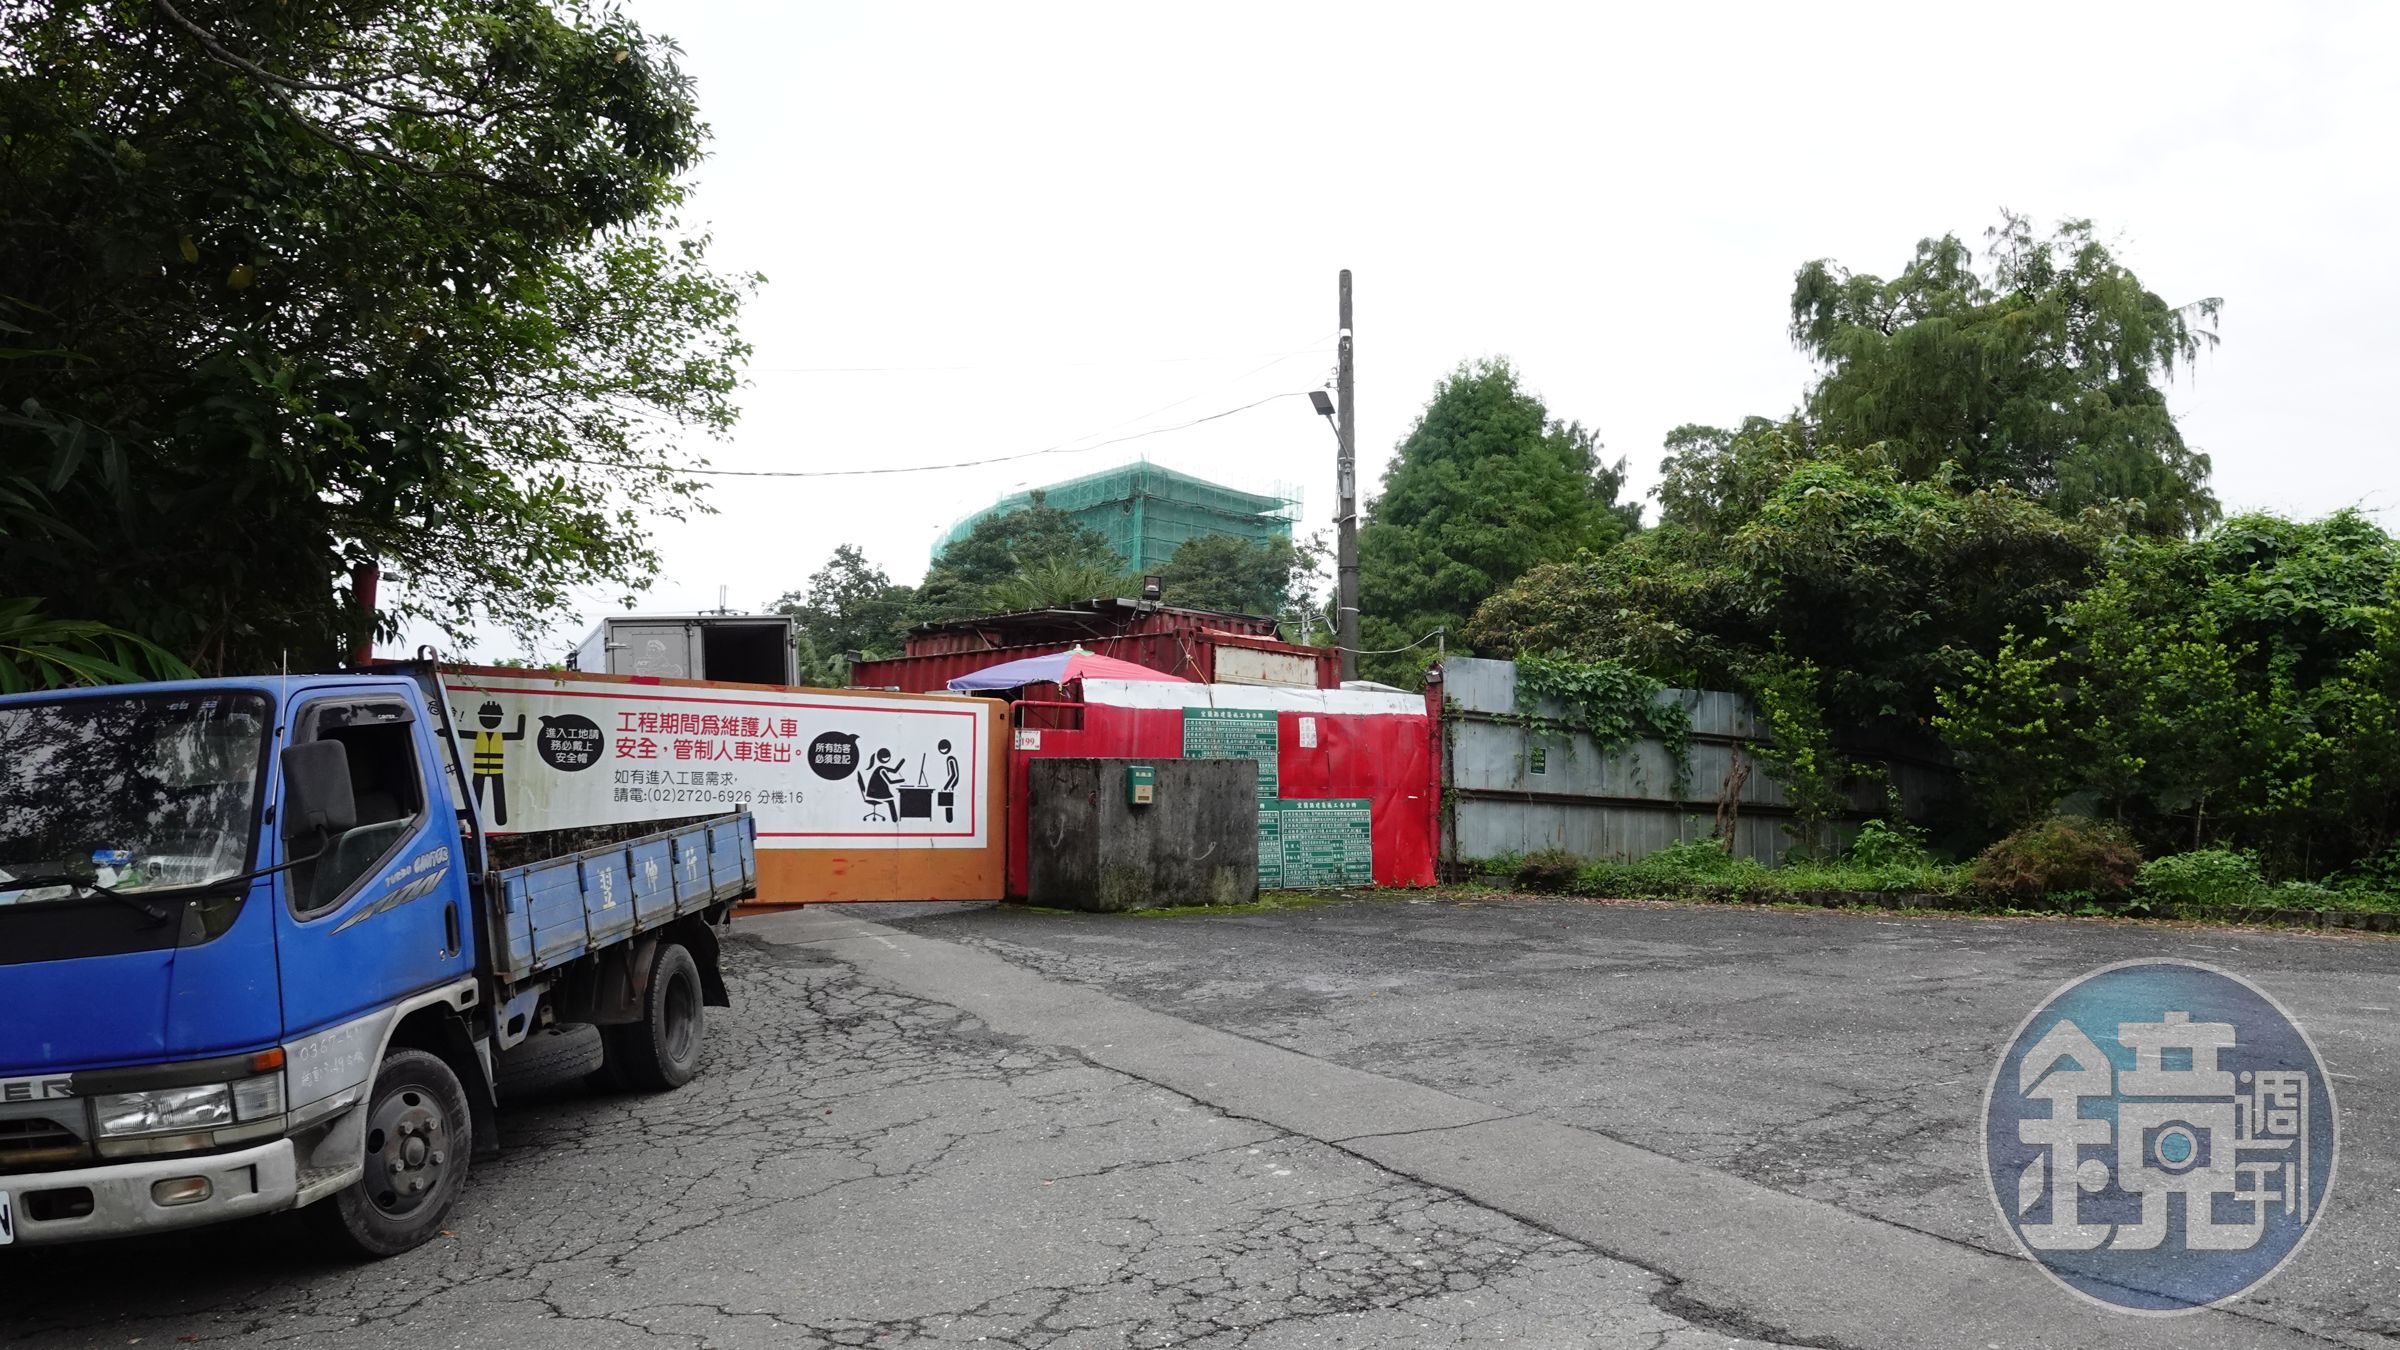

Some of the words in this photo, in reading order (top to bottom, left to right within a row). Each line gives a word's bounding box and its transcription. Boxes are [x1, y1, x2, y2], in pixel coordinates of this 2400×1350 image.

[545, 727, 600, 740] 進入工地請
[550, 739, 594, 752] 務必戴上
[815, 742, 852, 754] 所有訪客
[555, 752, 589, 764] 安全帽
[814, 753, 851, 765] 必須登記
